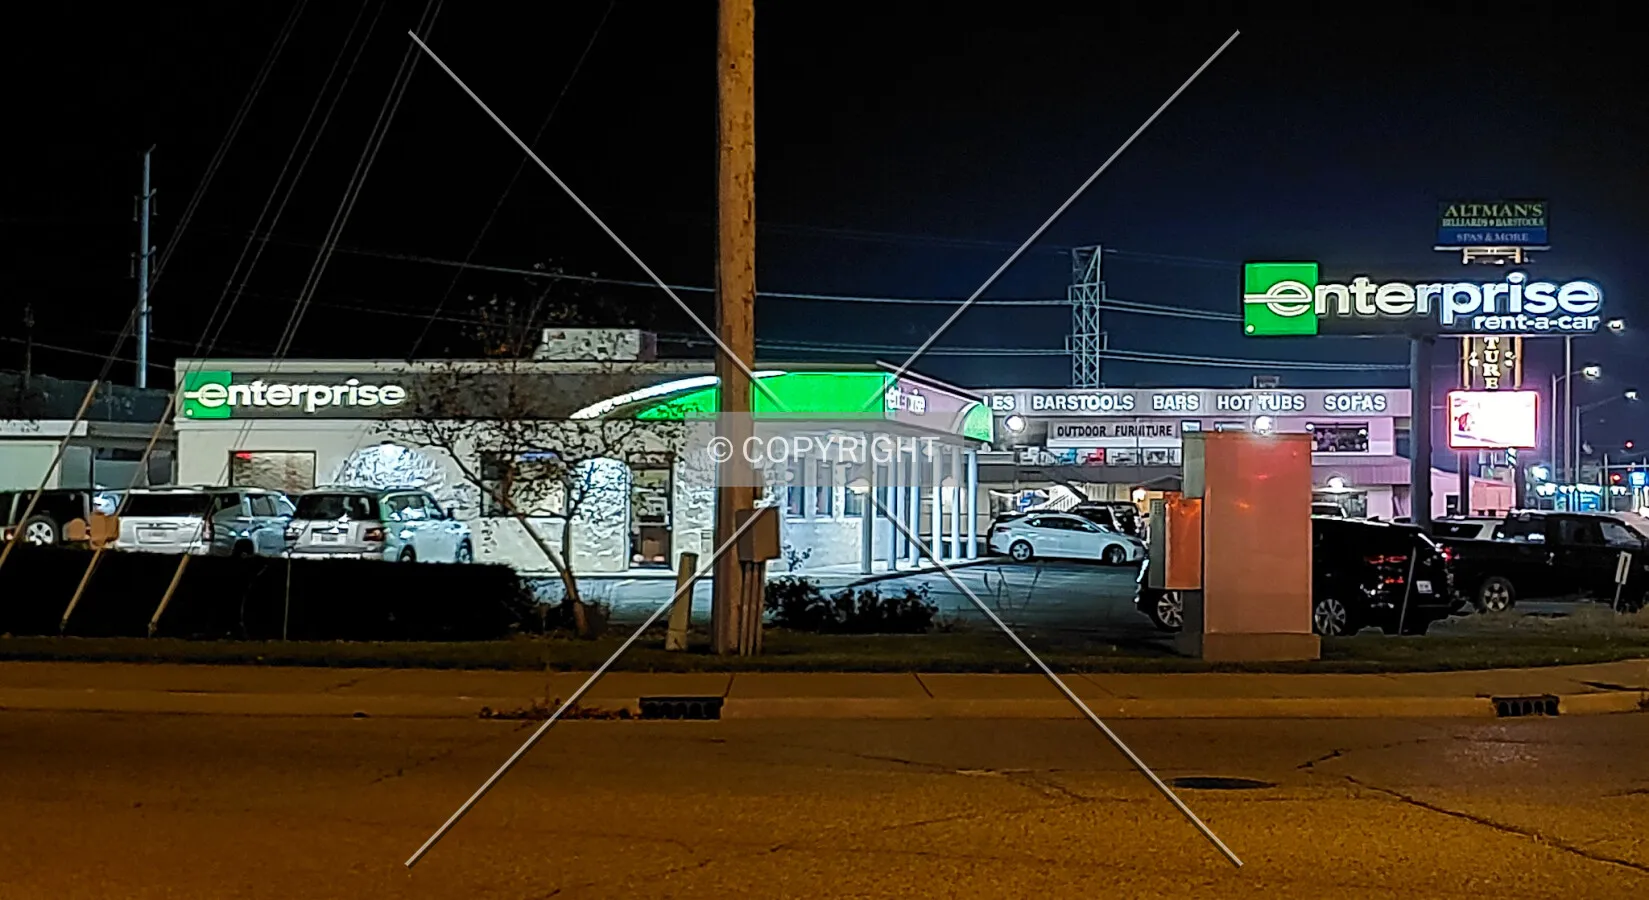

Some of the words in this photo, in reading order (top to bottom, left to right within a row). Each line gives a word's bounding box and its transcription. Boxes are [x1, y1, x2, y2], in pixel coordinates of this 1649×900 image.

[1445, 203, 1543, 217] ALTMAN'S
[1494, 233, 1529, 241] MORE
[1244, 272, 1601, 324] enterprise
[1472, 314, 1601, 332] rent-a-car
[184, 378, 406, 413] enterprise
[1032, 393, 1135, 411] BARSTOOLS
[1152, 393, 1200, 411] BARS
[1216, 393, 1252, 411] HOT
[1258, 393, 1306, 411] TUBS
[1323, 393, 1388, 411] SOFAS
[1056, 424, 1107, 438] OUTDOOR
[1114, 424, 1173, 437] FURNITURE
